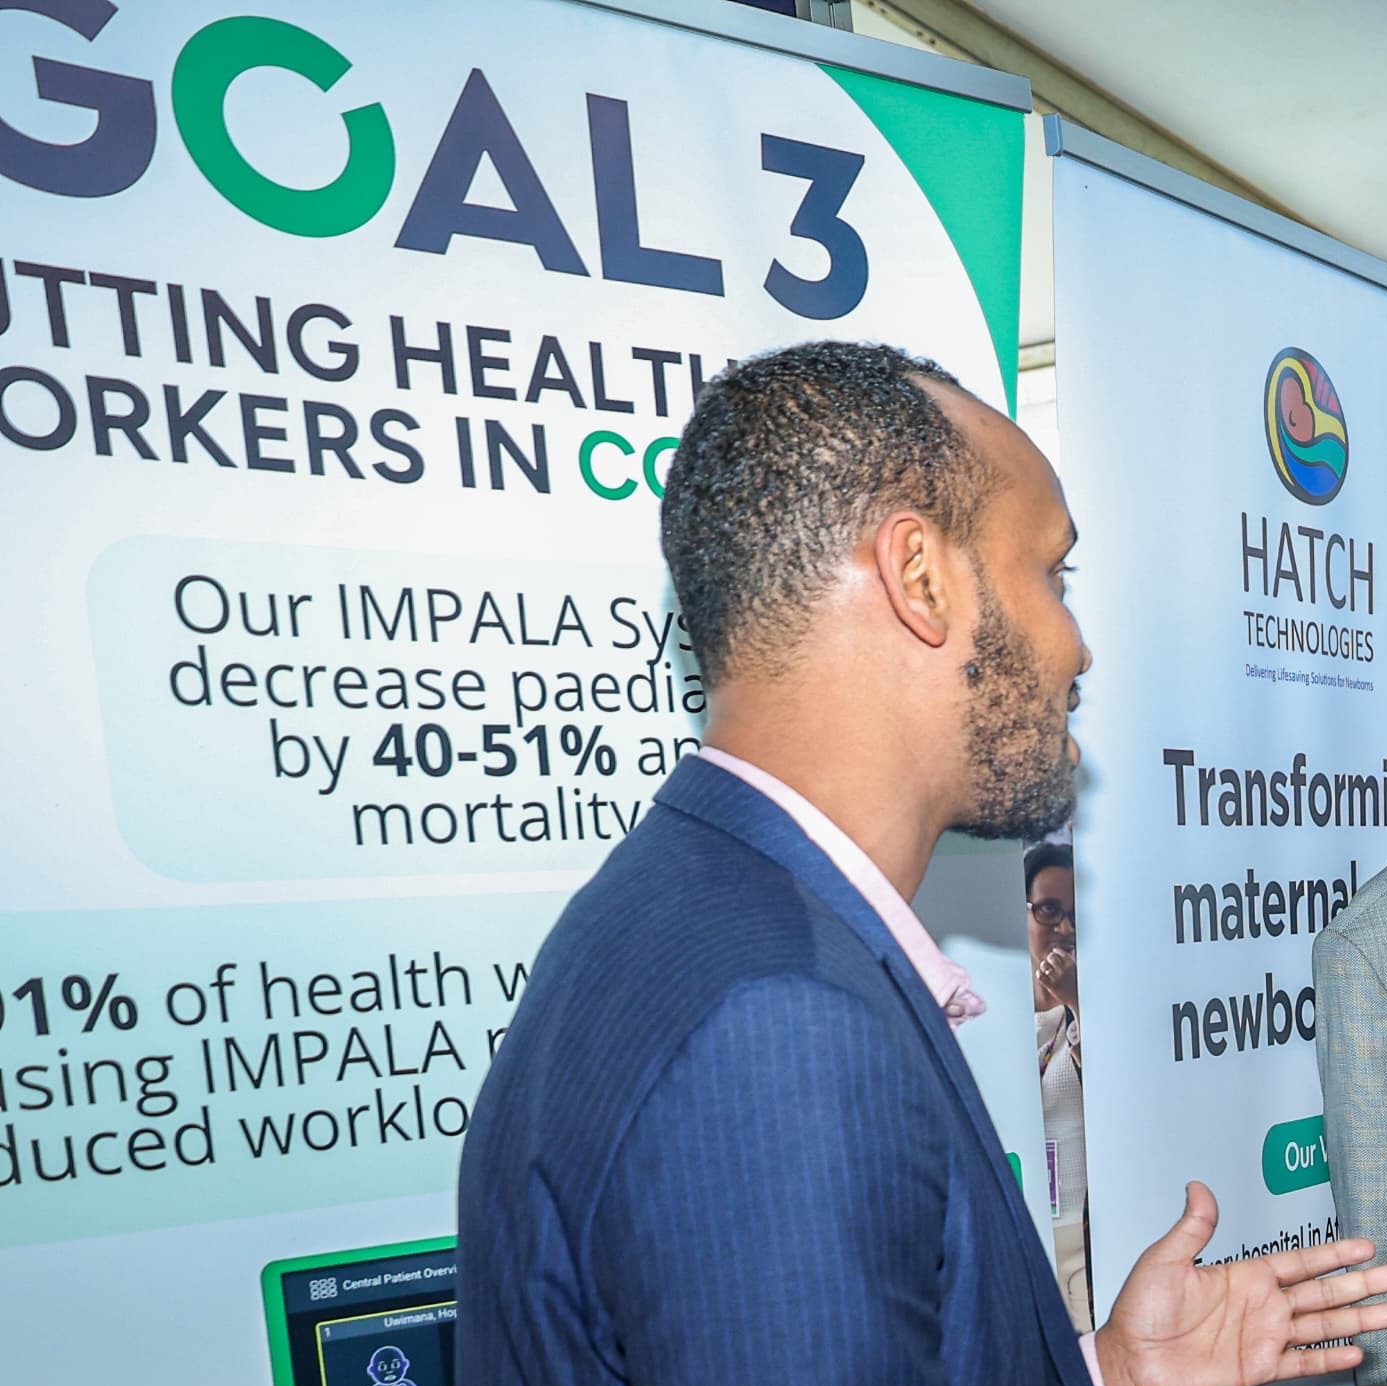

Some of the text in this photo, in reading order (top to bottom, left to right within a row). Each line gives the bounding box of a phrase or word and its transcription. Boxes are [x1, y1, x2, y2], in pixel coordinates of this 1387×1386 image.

[0, 0, 868, 320] GOAL 3
[0, 258, 360, 382] TTING
[456, 416, 551, 493] IN
[1241, 512, 1374, 615] HATCH
[173, 572, 312, 640] Our
[338, 583, 593, 648] IMPALA
[1243, 611, 1374, 663] TECHNOLOGIES
[168, 644, 707, 730] decrease paedia
[1245, 663, 1277, 683] Delivering
[1277, 667, 1310, 686] Lifesaving
[1311, 672, 1337, 687] Solutions
[1345, 677, 1374, 692] Newborns
[271, 717, 350, 792] by
[371, 724, 617, 778] 40-51%
[0, 973, 138, 1036] 1%
[166, 963, 238, 1027] of
[260, 951, 472, 1020] health
[0, 1020, 466, 1118] sing IMPALA
[1285, 1141, 1316, 1171] Our
[342, 1278, 382, 1291] Central
[383, 1270, 422, 1285] Patient
